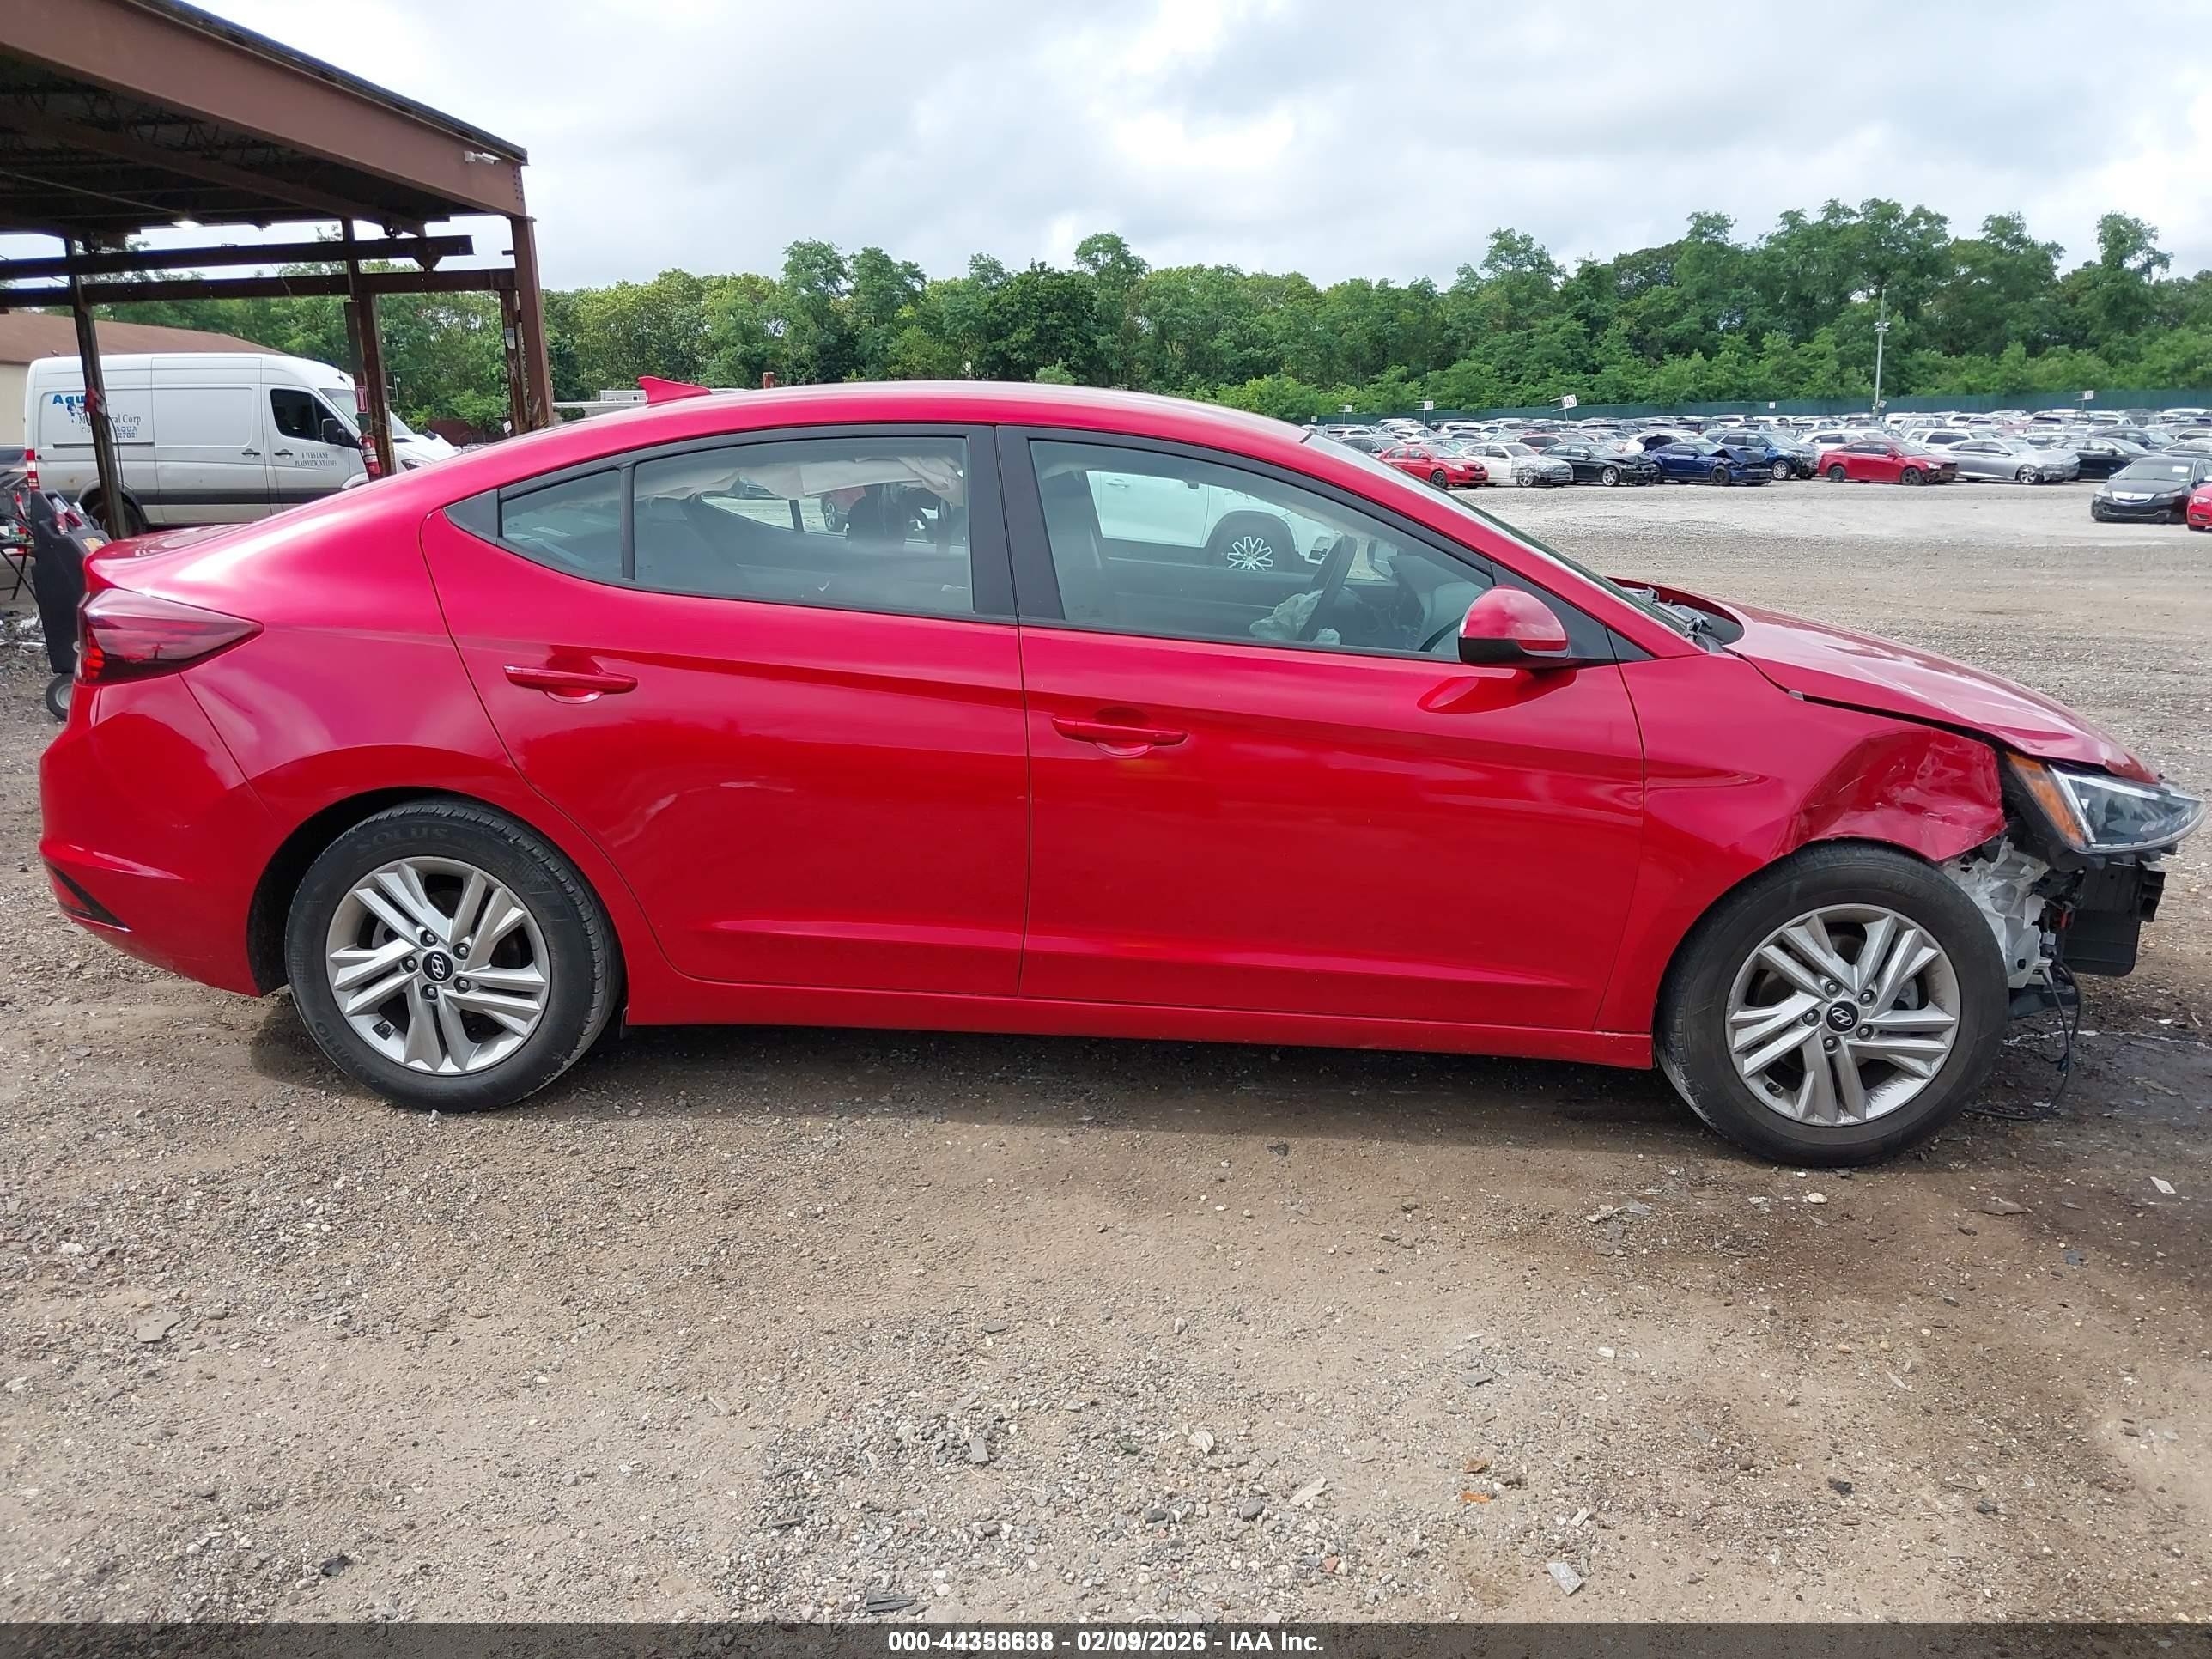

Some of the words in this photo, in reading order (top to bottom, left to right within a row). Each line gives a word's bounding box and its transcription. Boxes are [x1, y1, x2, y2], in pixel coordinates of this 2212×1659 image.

[52, 394, 86, 405] Aqu
[1565, 396, 1576, 406] 40
[122, 414, 141, 426] Corp
